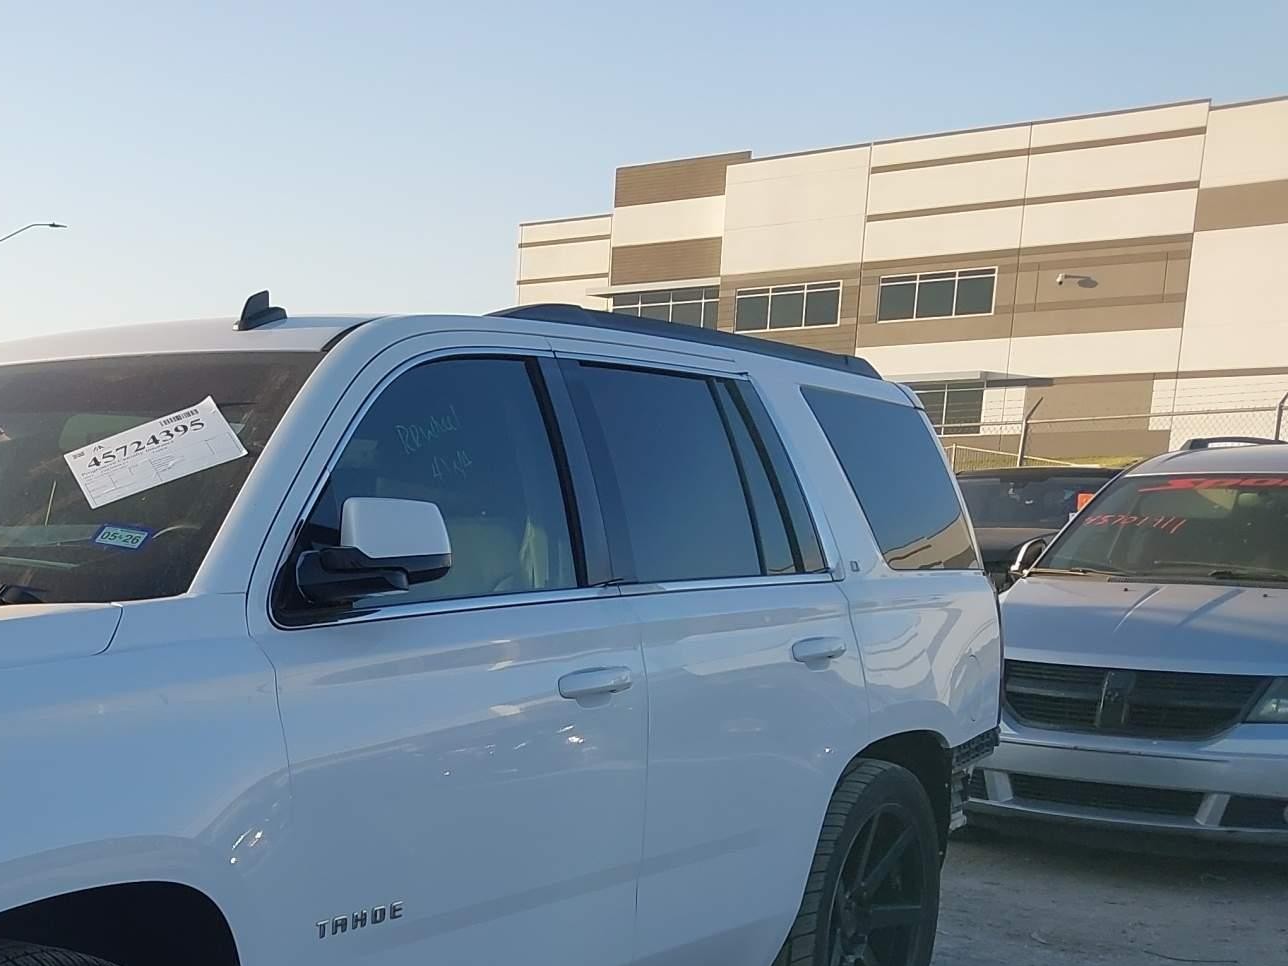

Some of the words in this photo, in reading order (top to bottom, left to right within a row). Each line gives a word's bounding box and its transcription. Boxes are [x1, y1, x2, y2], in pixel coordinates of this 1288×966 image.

[87, 418, 205, 468] 45724395
[101, 531, 120, 541] 05
[122, 534, 142, 545] 26
[316, 900, 404, 939] TAHOE
